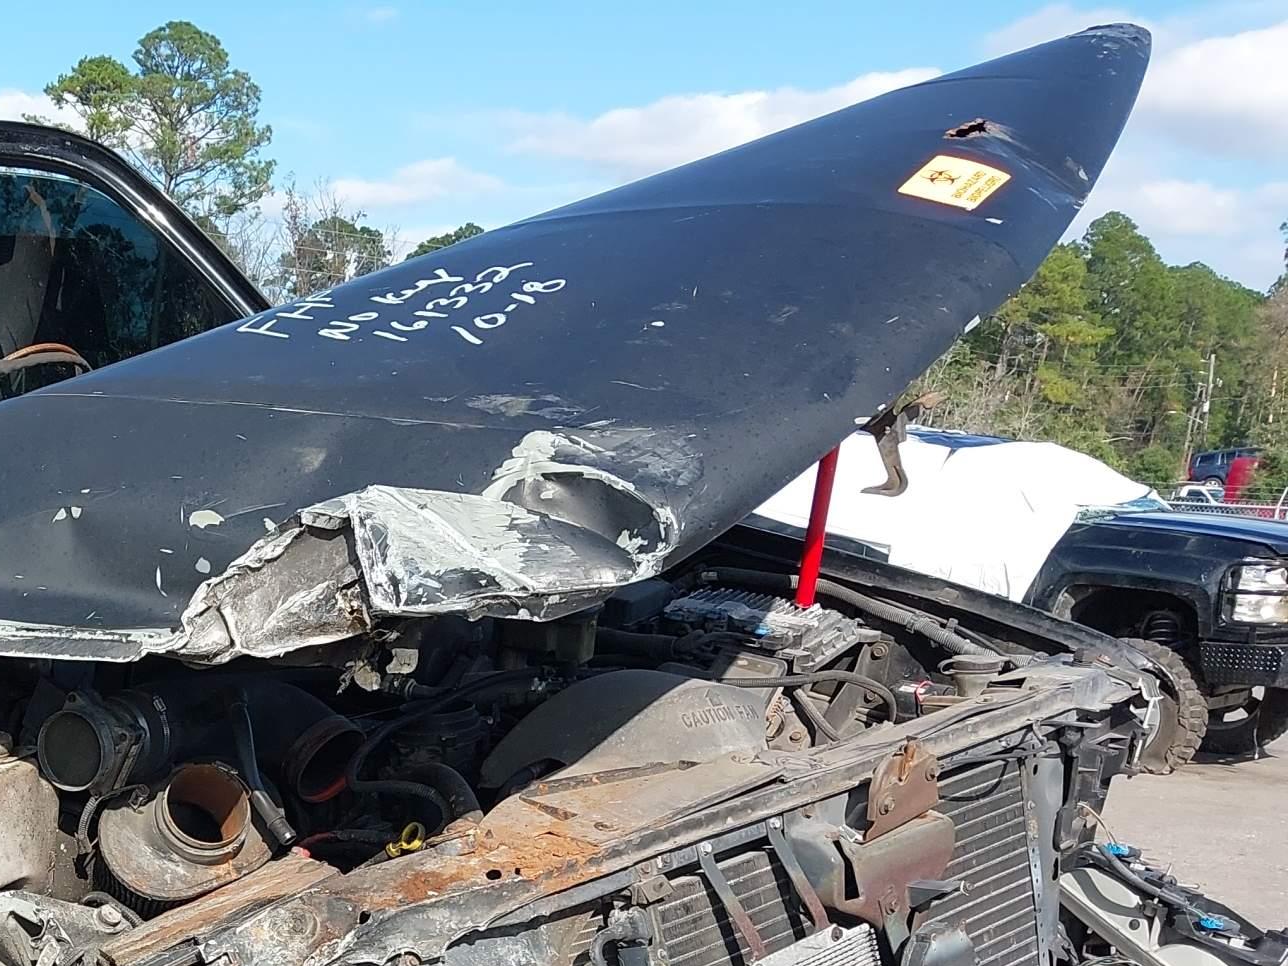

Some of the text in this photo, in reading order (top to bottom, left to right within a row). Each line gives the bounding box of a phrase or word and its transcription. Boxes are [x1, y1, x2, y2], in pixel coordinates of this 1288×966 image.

[372, 261, 534, 342] 161332
[450, 278, 567, 345] 10-18
[681, 704, 759, 729] CAUTION FAN
